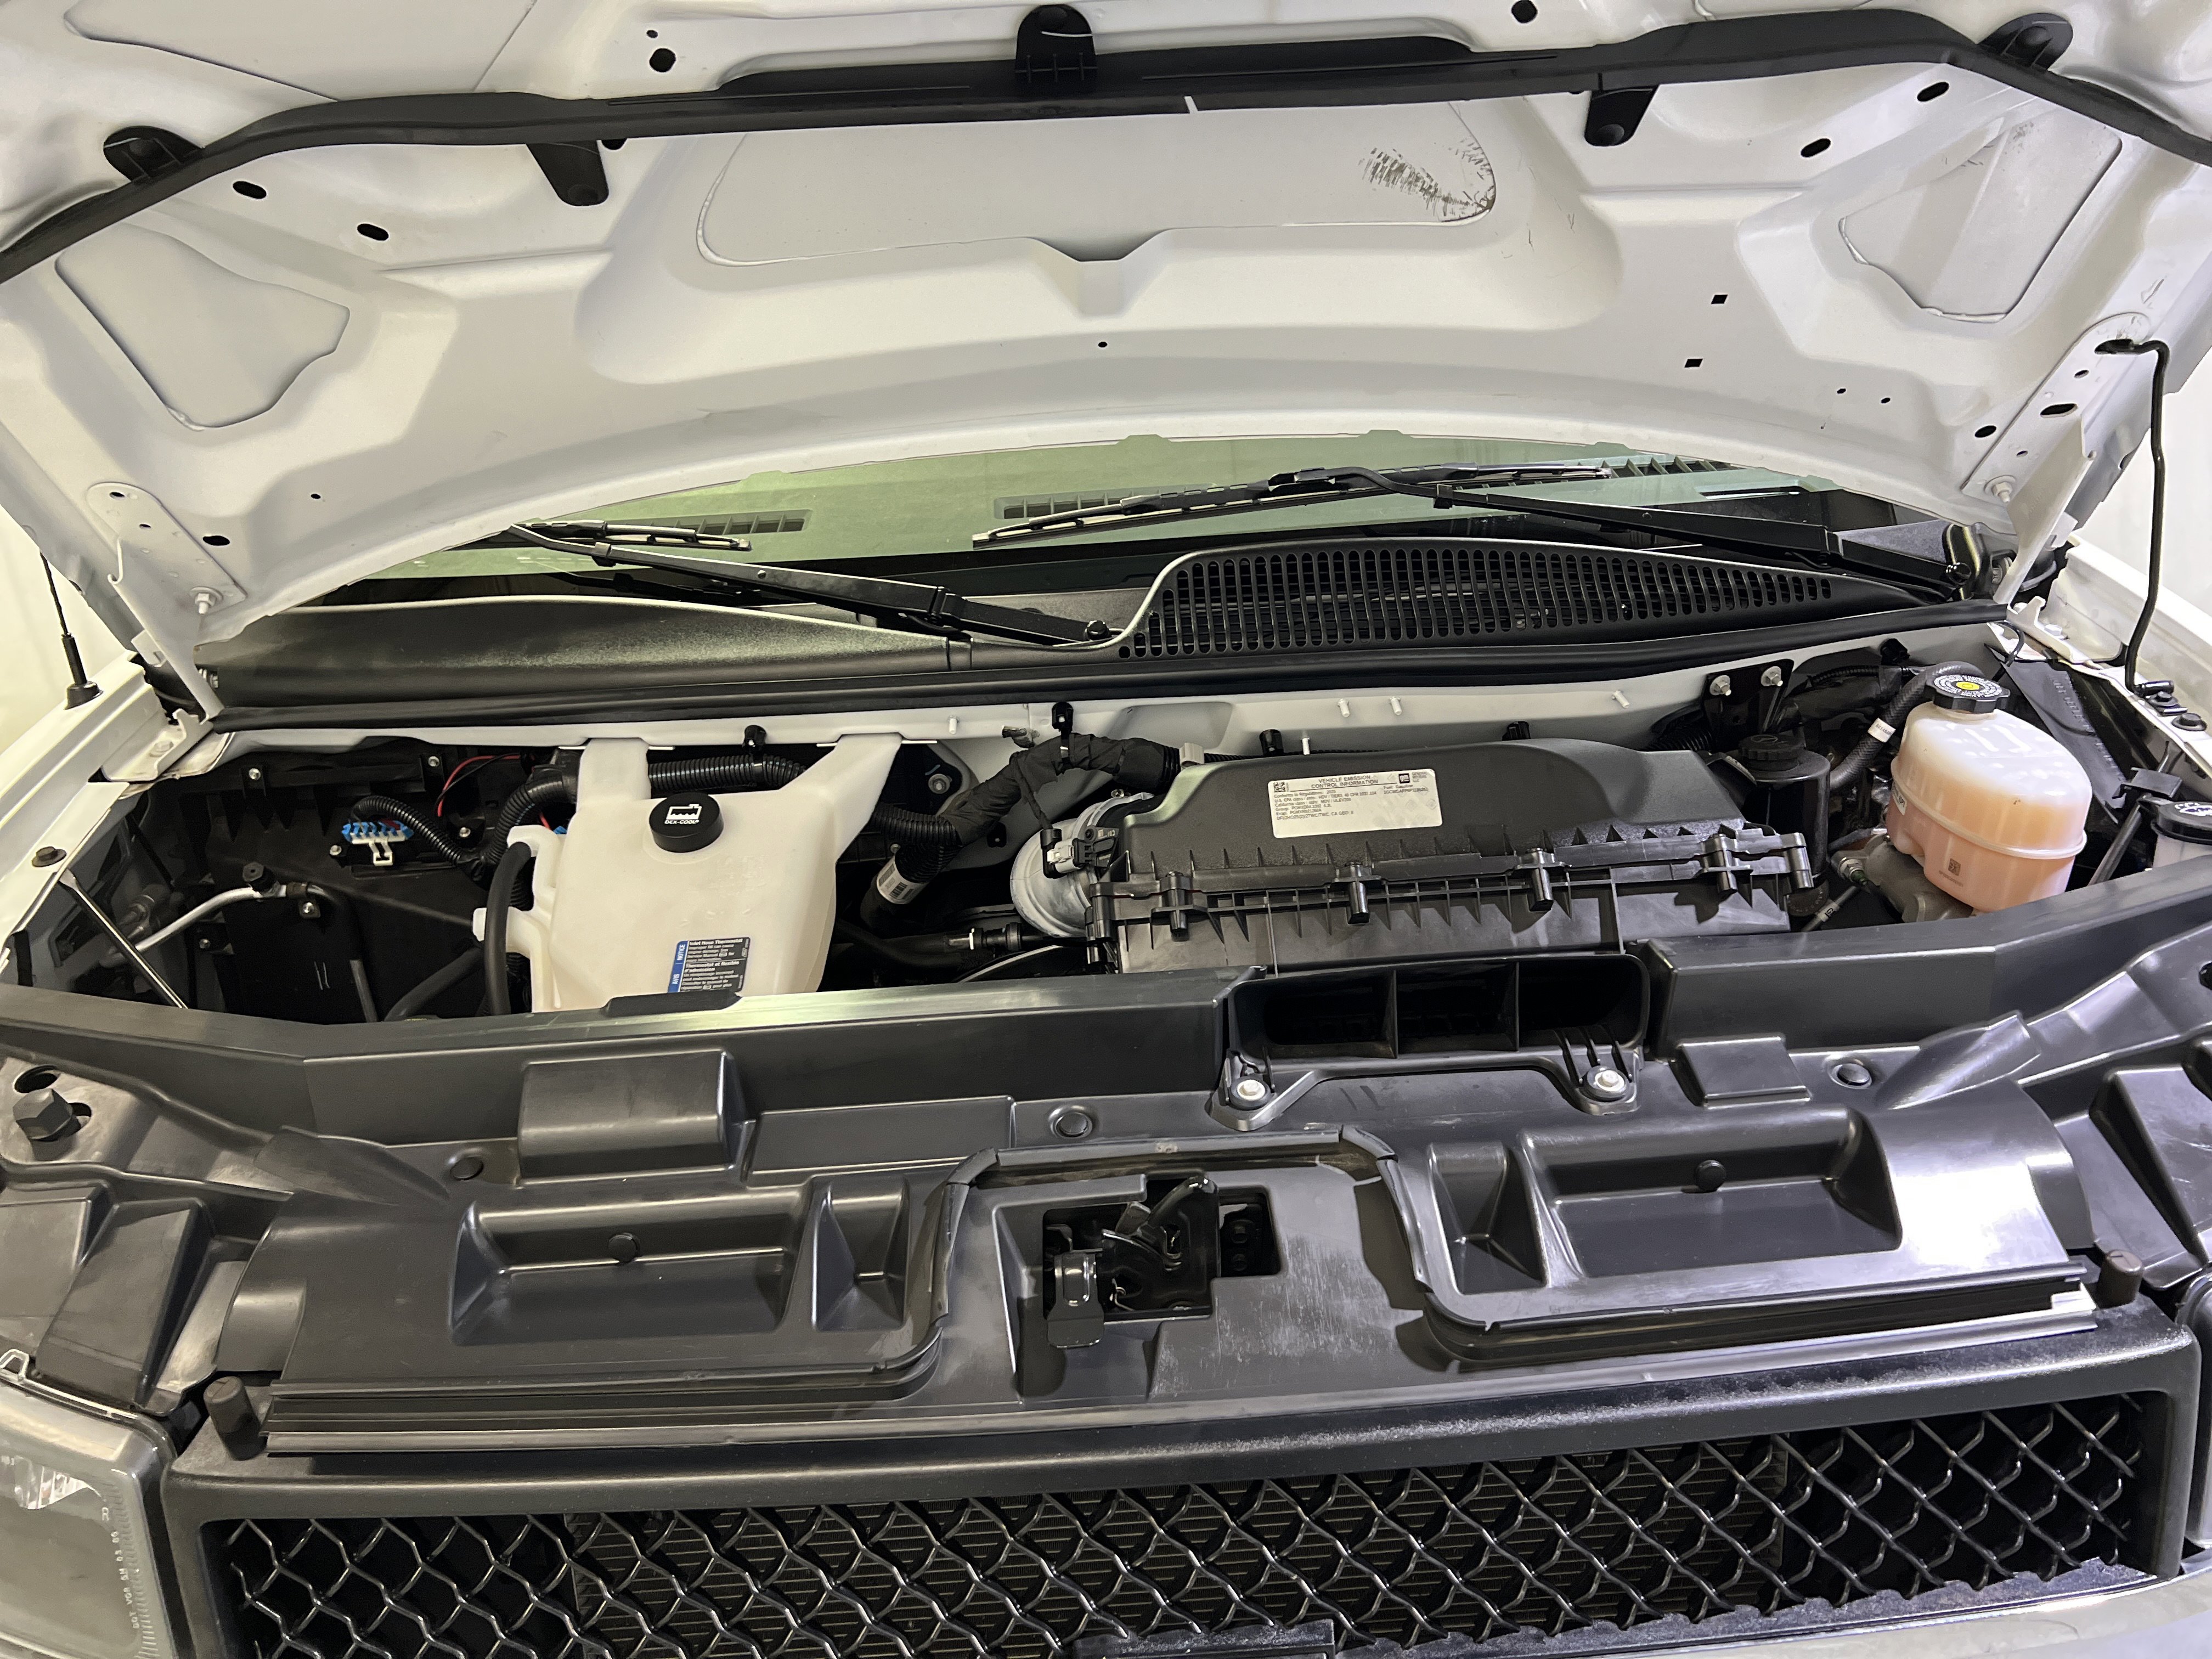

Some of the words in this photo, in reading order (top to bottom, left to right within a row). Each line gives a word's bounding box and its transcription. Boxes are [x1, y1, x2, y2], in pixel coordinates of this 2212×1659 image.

[676, 944, 686, 961] NOTICE
[672, 973, 680, 985] AVIS
[122, 1587, 133, 1605] VOR
[128, 1610, 140, 1629] DOT
